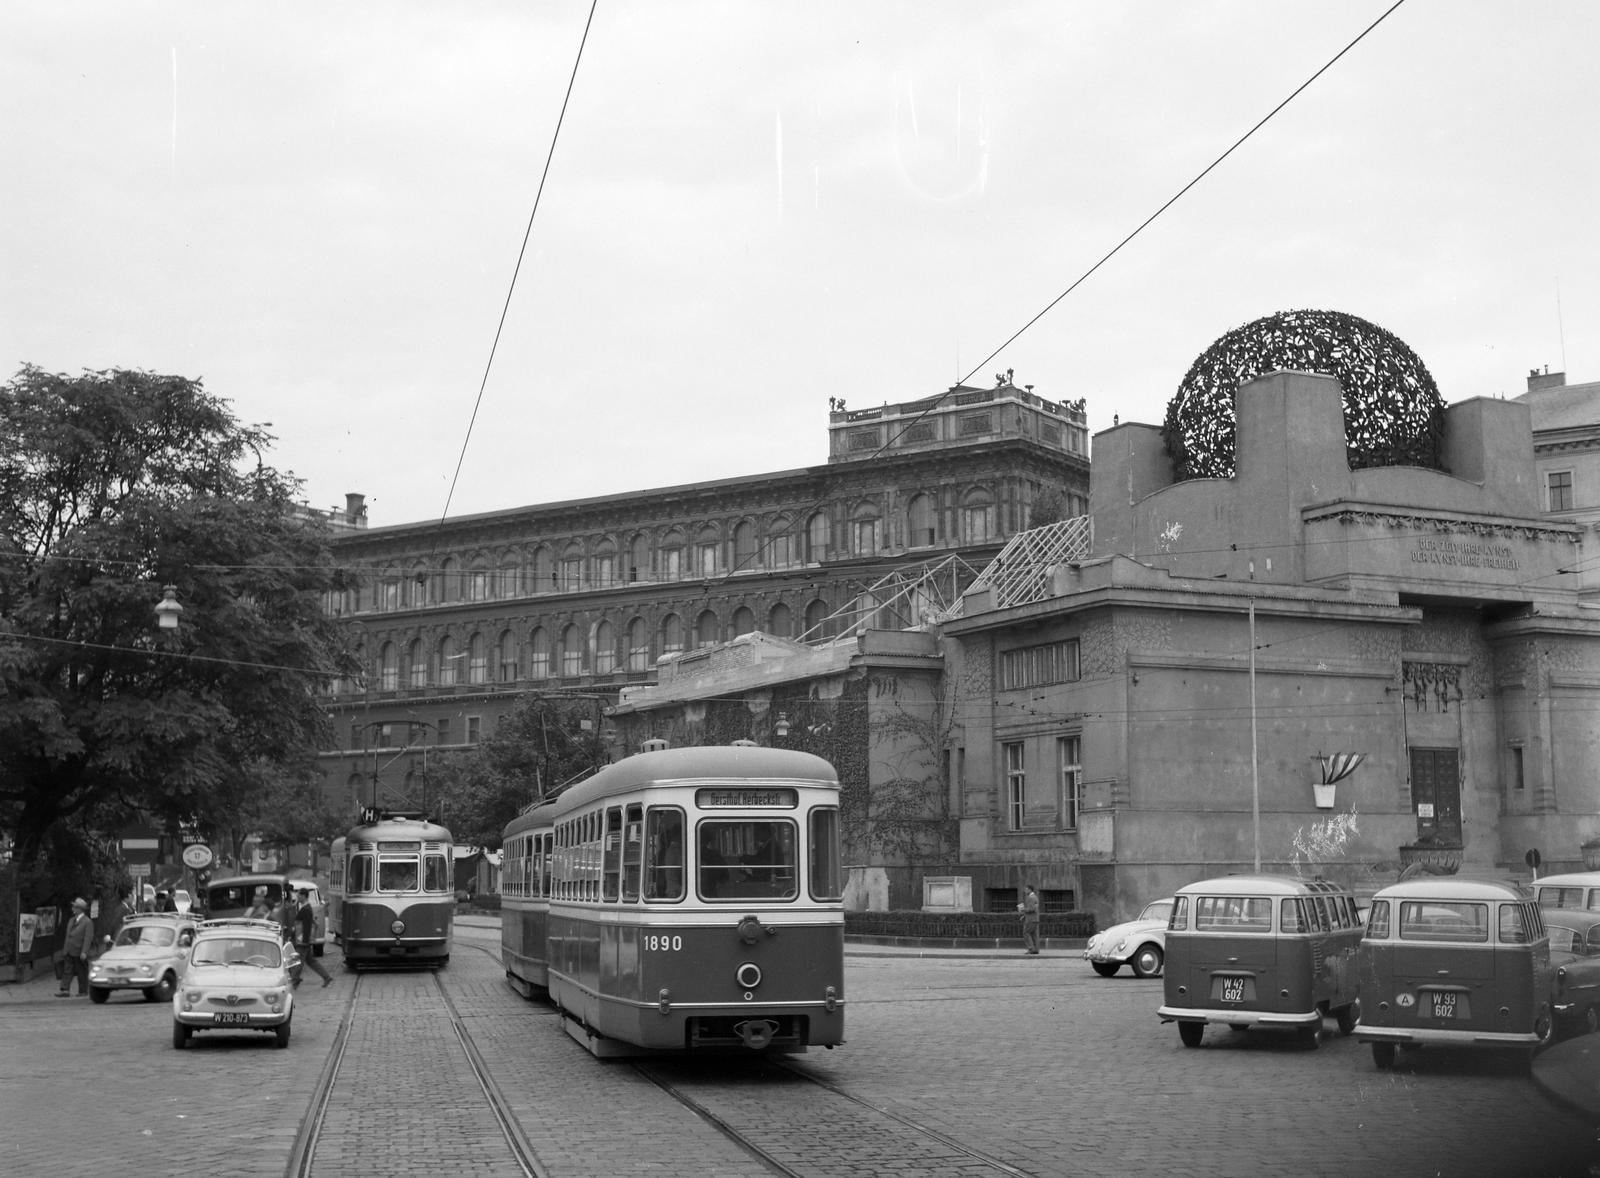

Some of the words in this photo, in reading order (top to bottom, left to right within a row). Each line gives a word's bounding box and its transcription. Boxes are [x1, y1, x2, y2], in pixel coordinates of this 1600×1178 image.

[1411, 551, 1428, 563] DER
[365, 809, 374, 821] H
[644, 935, 682, 951] 1890
[1223, 978, 1232, 990] W
[1233, 978, 1244, 990] 42
[1225, 989, 1242, 1000] 602
[1401, 994, 1410, 1004] A
[1433, 992, 1442, 1004] W
[1444, 992, 1456, 1005] 93
[1435, 1004, 1453, 1017] 602
[214, 1013, 221, 1022] W
